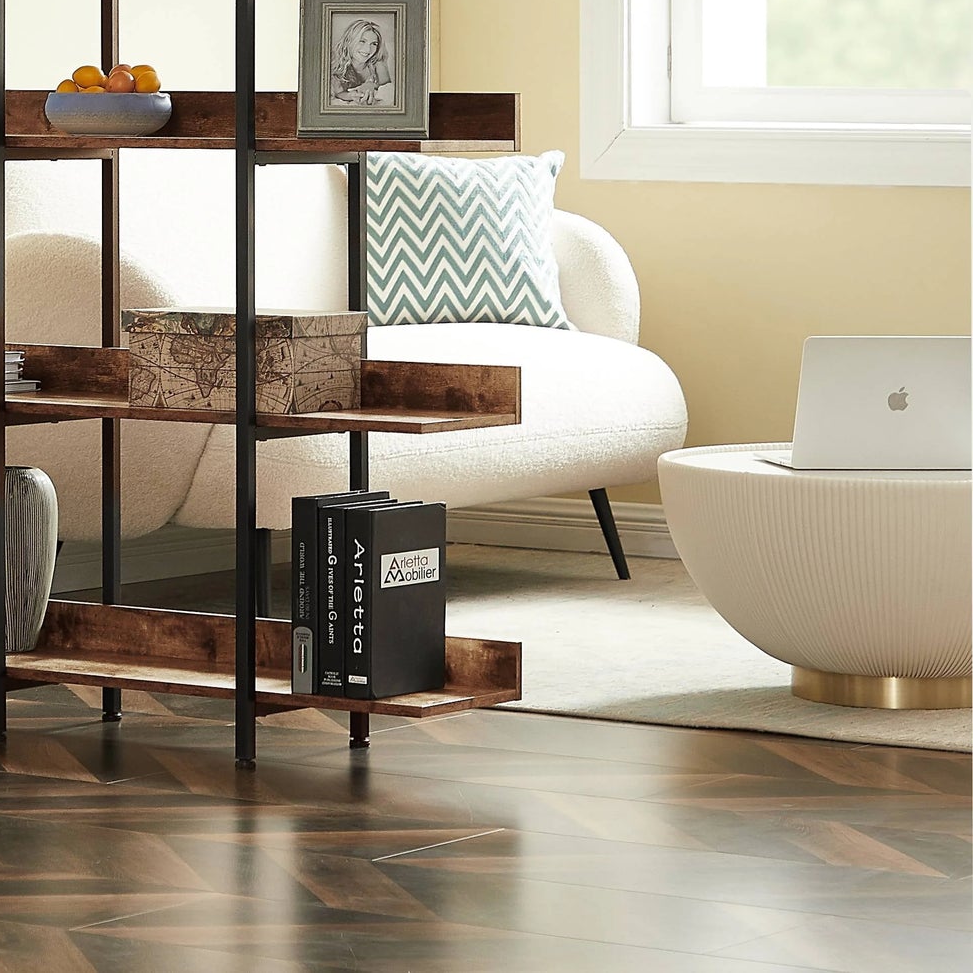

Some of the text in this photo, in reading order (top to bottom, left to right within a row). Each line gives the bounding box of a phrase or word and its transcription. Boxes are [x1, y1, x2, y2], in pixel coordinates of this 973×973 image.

[390, 555, 429, 570] Arletta
[384, 566, 437, 584] Mobilier
[353, 538, 366, 654] Arletta
